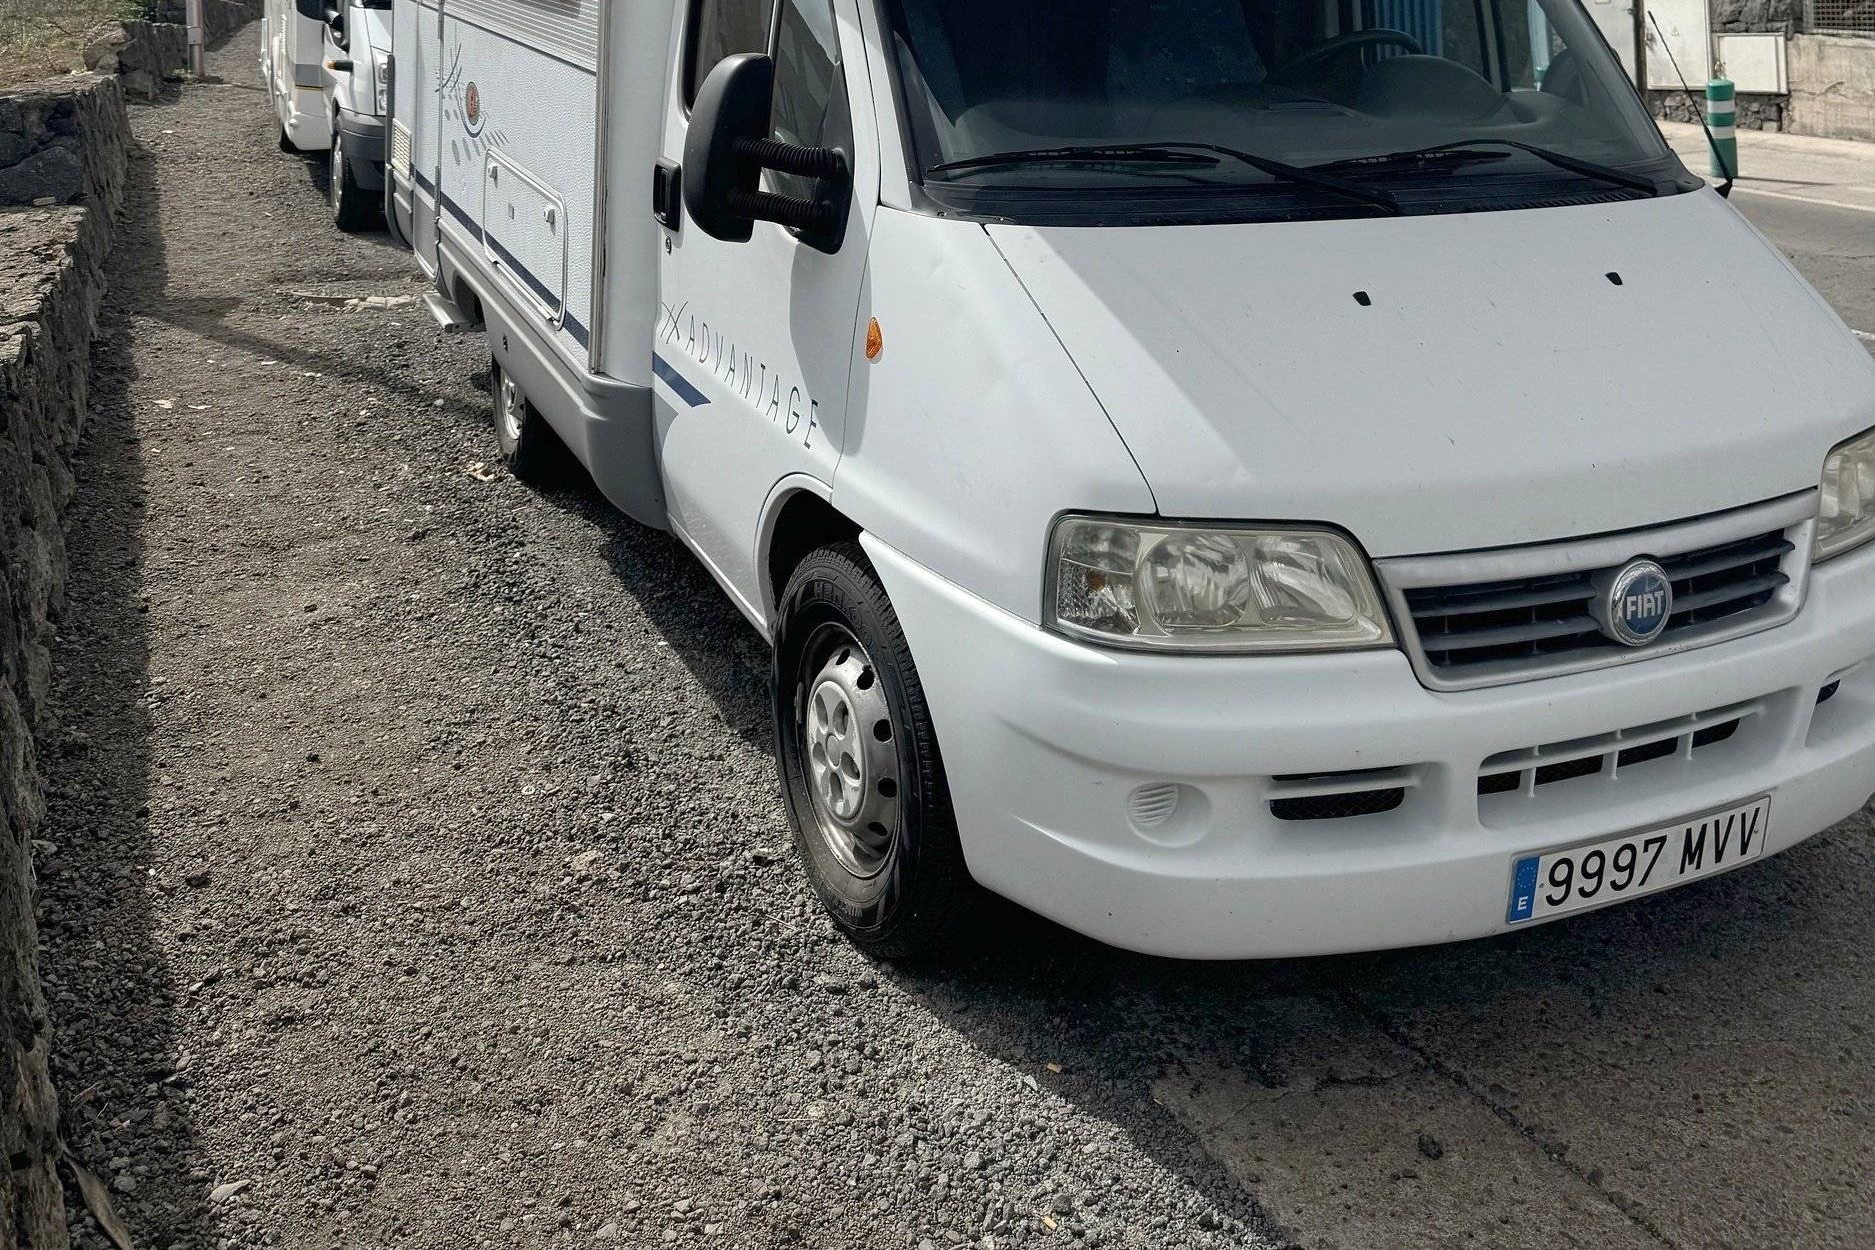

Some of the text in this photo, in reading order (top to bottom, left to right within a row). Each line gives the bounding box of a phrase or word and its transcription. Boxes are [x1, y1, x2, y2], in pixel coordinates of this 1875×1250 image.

[685, 314, 819, 450] ADVANTAGE
[1625, 590, 1665, 620] FIAT
[1545, 806, 1761, 907] 9997 MVV
[1516, 896, 1528, 911] E
